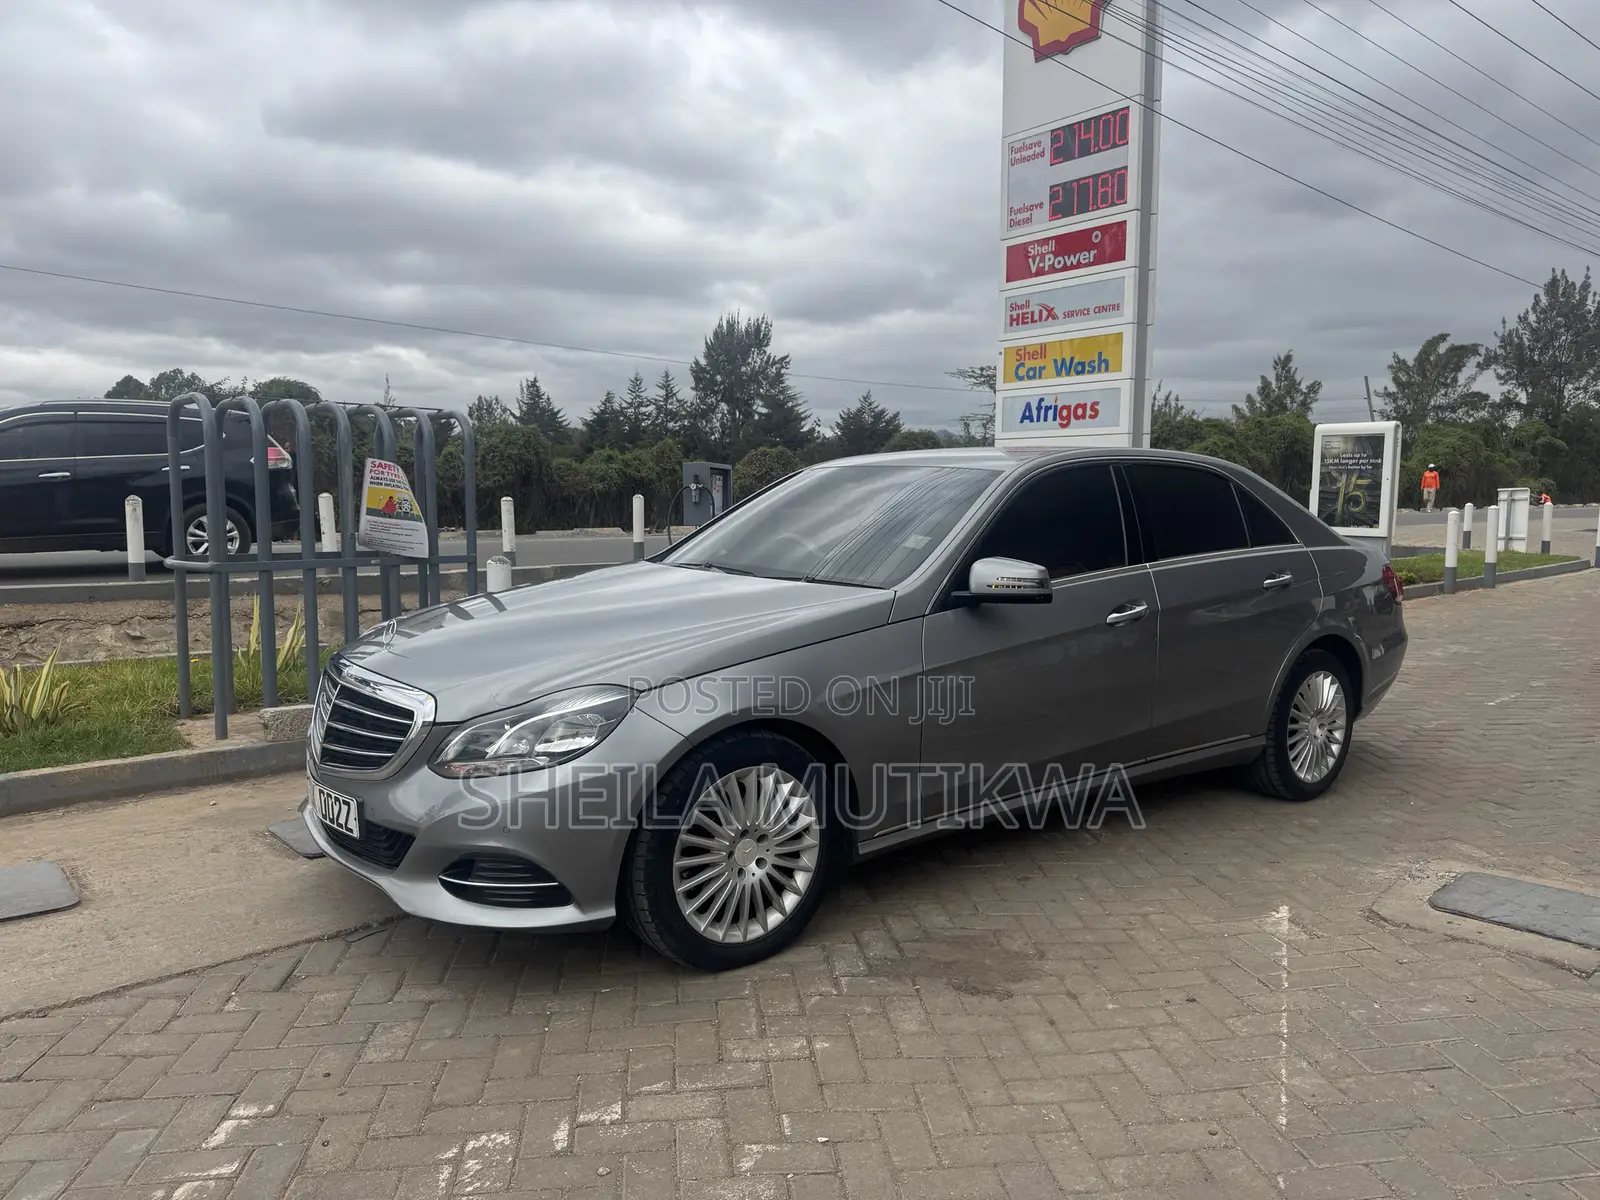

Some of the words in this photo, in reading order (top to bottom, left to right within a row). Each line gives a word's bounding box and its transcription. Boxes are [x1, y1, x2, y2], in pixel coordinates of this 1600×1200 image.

[1050, 109, 1129, 165] 214.00
[1010, 140, 1042, 155] Fuelsave
[1010, 148, 1045, 166] Unleaded
[1049, 169, 1128, 221] 217.80
[1009, 201, 1044, 217] Fuelsave
[1009, 216, 1033, 228] Diesel
[1027, 240, 1055, 256] Shell
[1028, 249, 1097, 274] V-Power
[1009, 300, 1030, 312] Shell
[1009, 303, 1059, 327] HELIX
[1062, 308, 1090, 319] SERVICE
[1093, 303, 1120, 314] CENTRE
[1015, 344, 1047, 362] Shell
[1014, 362, 1046, 381] Car
[1053, 352, 1109, 377] Wash
[1019, 395, 1100, 429] Afrigas
